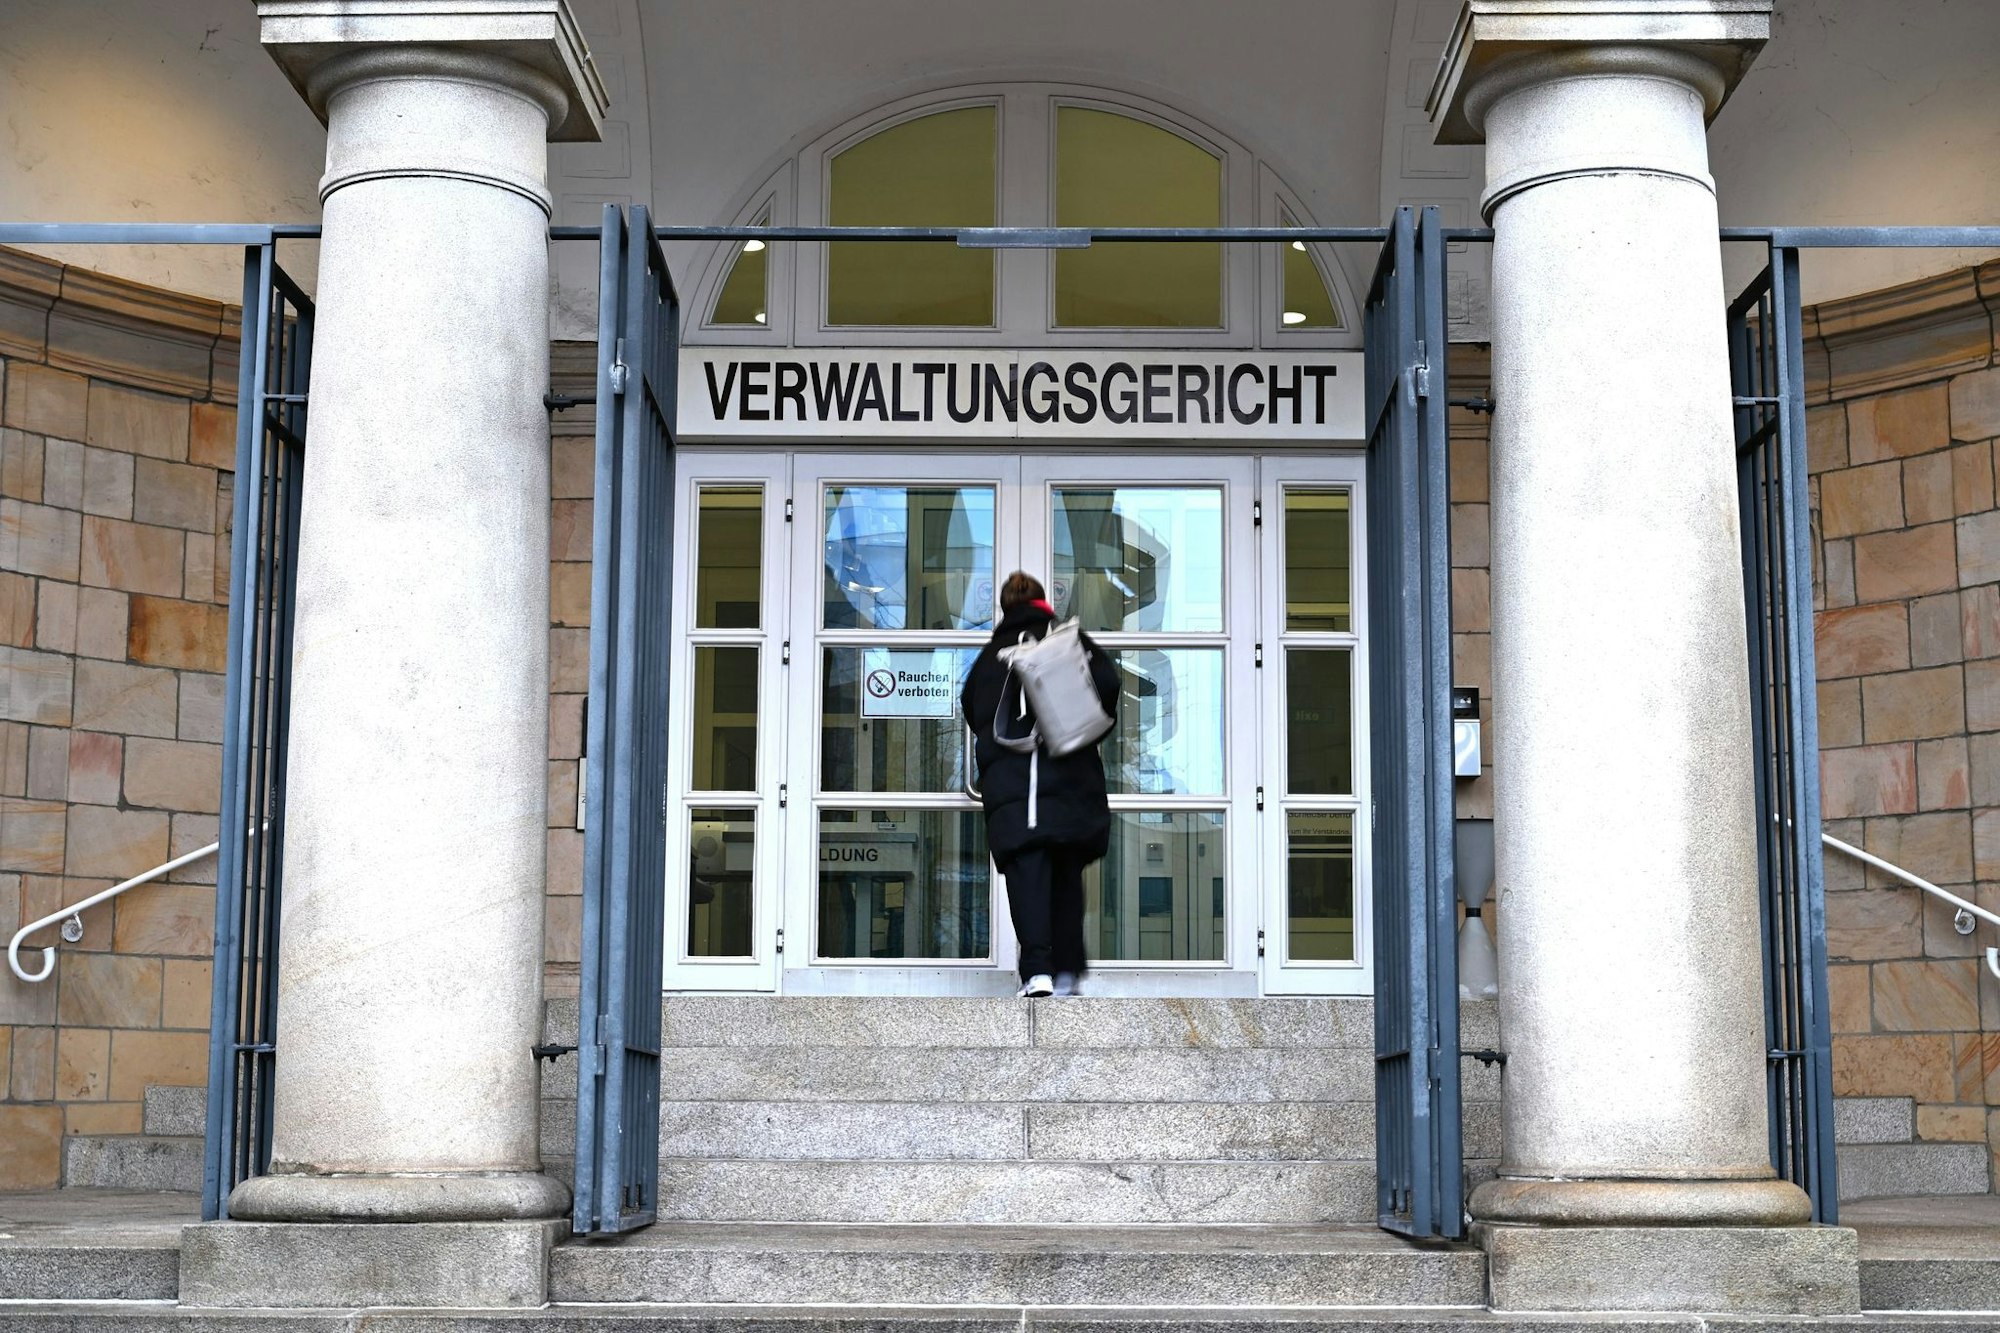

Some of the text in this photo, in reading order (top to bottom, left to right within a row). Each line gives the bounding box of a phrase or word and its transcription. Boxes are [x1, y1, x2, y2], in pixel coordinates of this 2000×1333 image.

[703, 361, 1337, 426] VERWALTUNGSGERICHT
[898, 670, 949, 683] Rauchen
[898, 685, 949, 698] verboten
